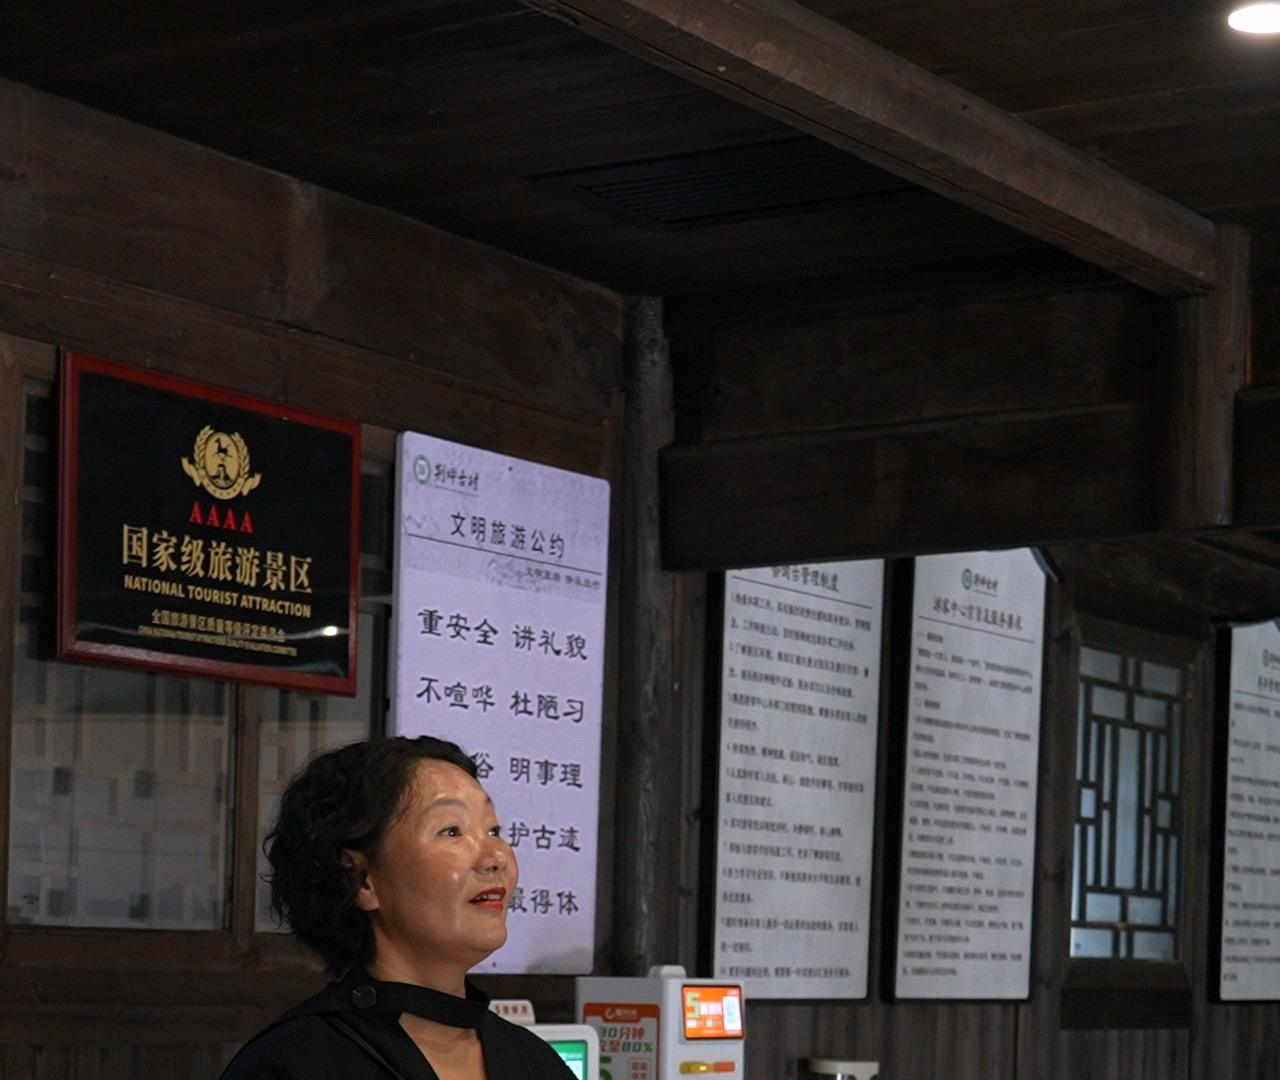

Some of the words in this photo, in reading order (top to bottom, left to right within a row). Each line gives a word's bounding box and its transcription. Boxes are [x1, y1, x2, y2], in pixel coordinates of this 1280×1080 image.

[189, 502, 254, 534] AAAA
[450, 512, 565, 559] 文明旅游公约
[122, 524, 314, 594] 国家级旅游景区
[124, 574, 185, 598] NATIONAL
[187, 585, 239, 607] TOURIST
[240, 595, 312, 618] ATTRACTION
[417, 609, 498, 646] 重安全
[511, 624, 588, 661] 讲礼貌
[416, 676, 496, 712] 不喧哗
[509, 690, 585, 723] 杜陋习
[510, 756, 584, 788] 明事理
